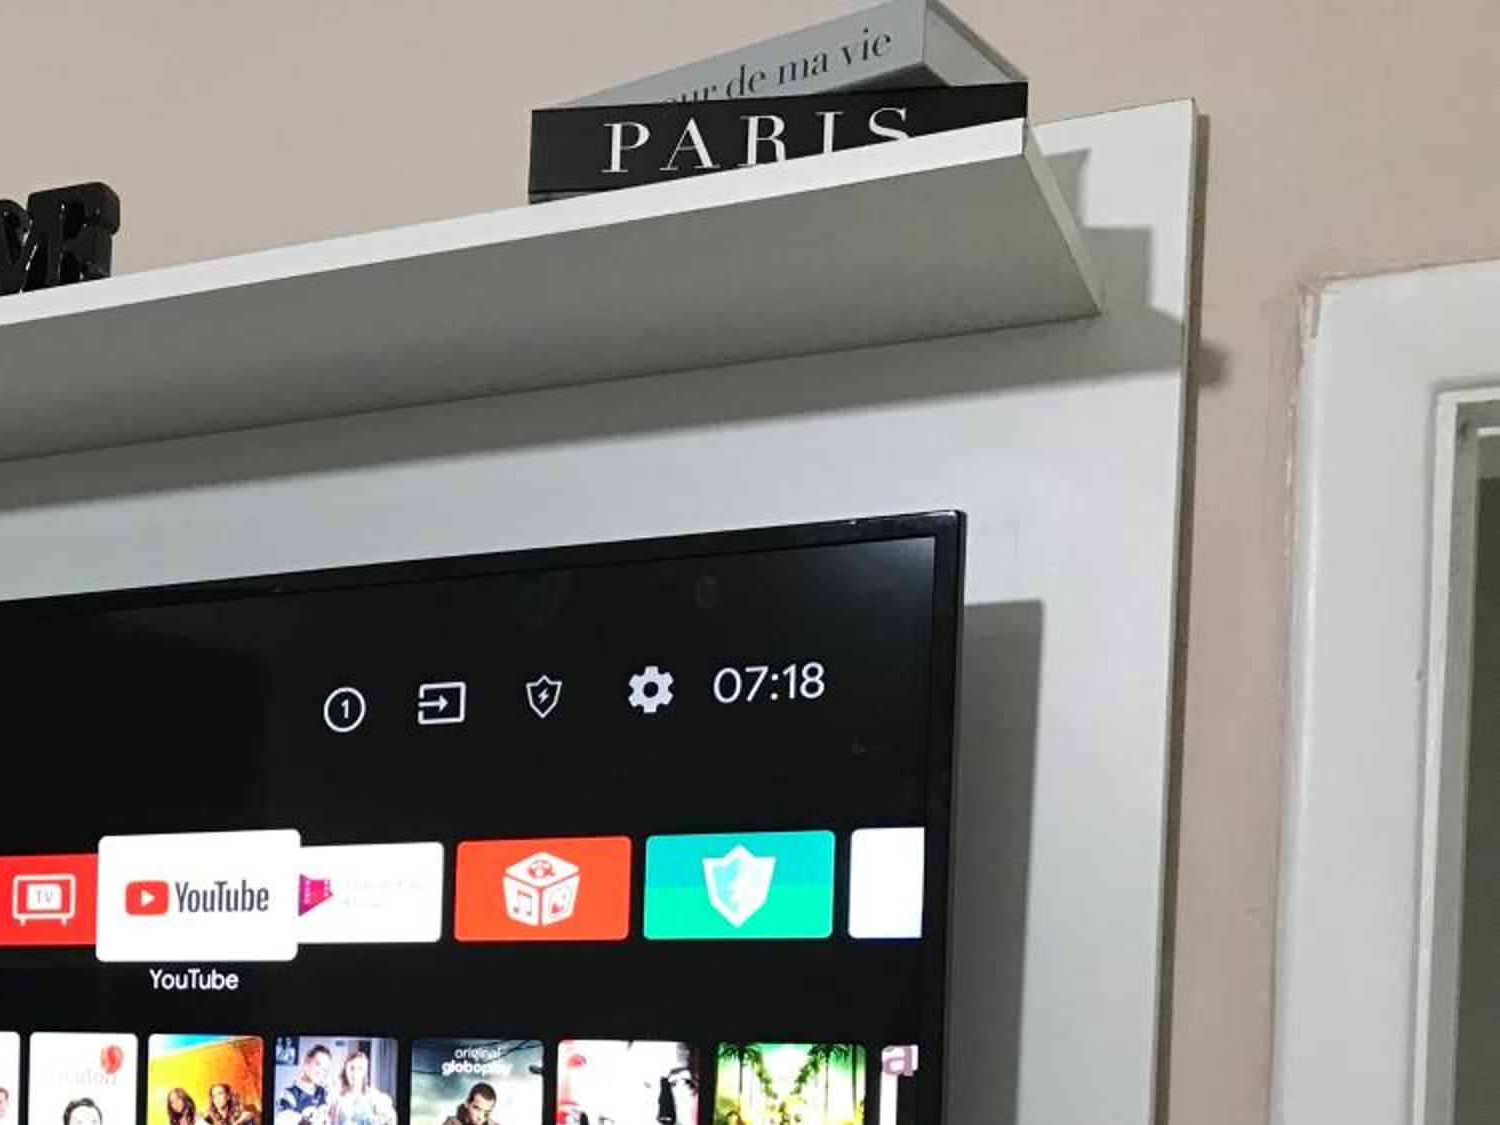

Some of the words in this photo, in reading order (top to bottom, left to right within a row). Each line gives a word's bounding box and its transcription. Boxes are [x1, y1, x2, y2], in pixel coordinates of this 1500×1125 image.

[725, 64, 766, 100] de
[777, 52, 829, 85] ma
[841, 27, 891, 66] vie
[602, 107, 910, 173] PARIS
[713, 662, 826, 704] 07:18
[175, 880, 269, 914] YouTube
[149, 969, 239, 990] YouTube
